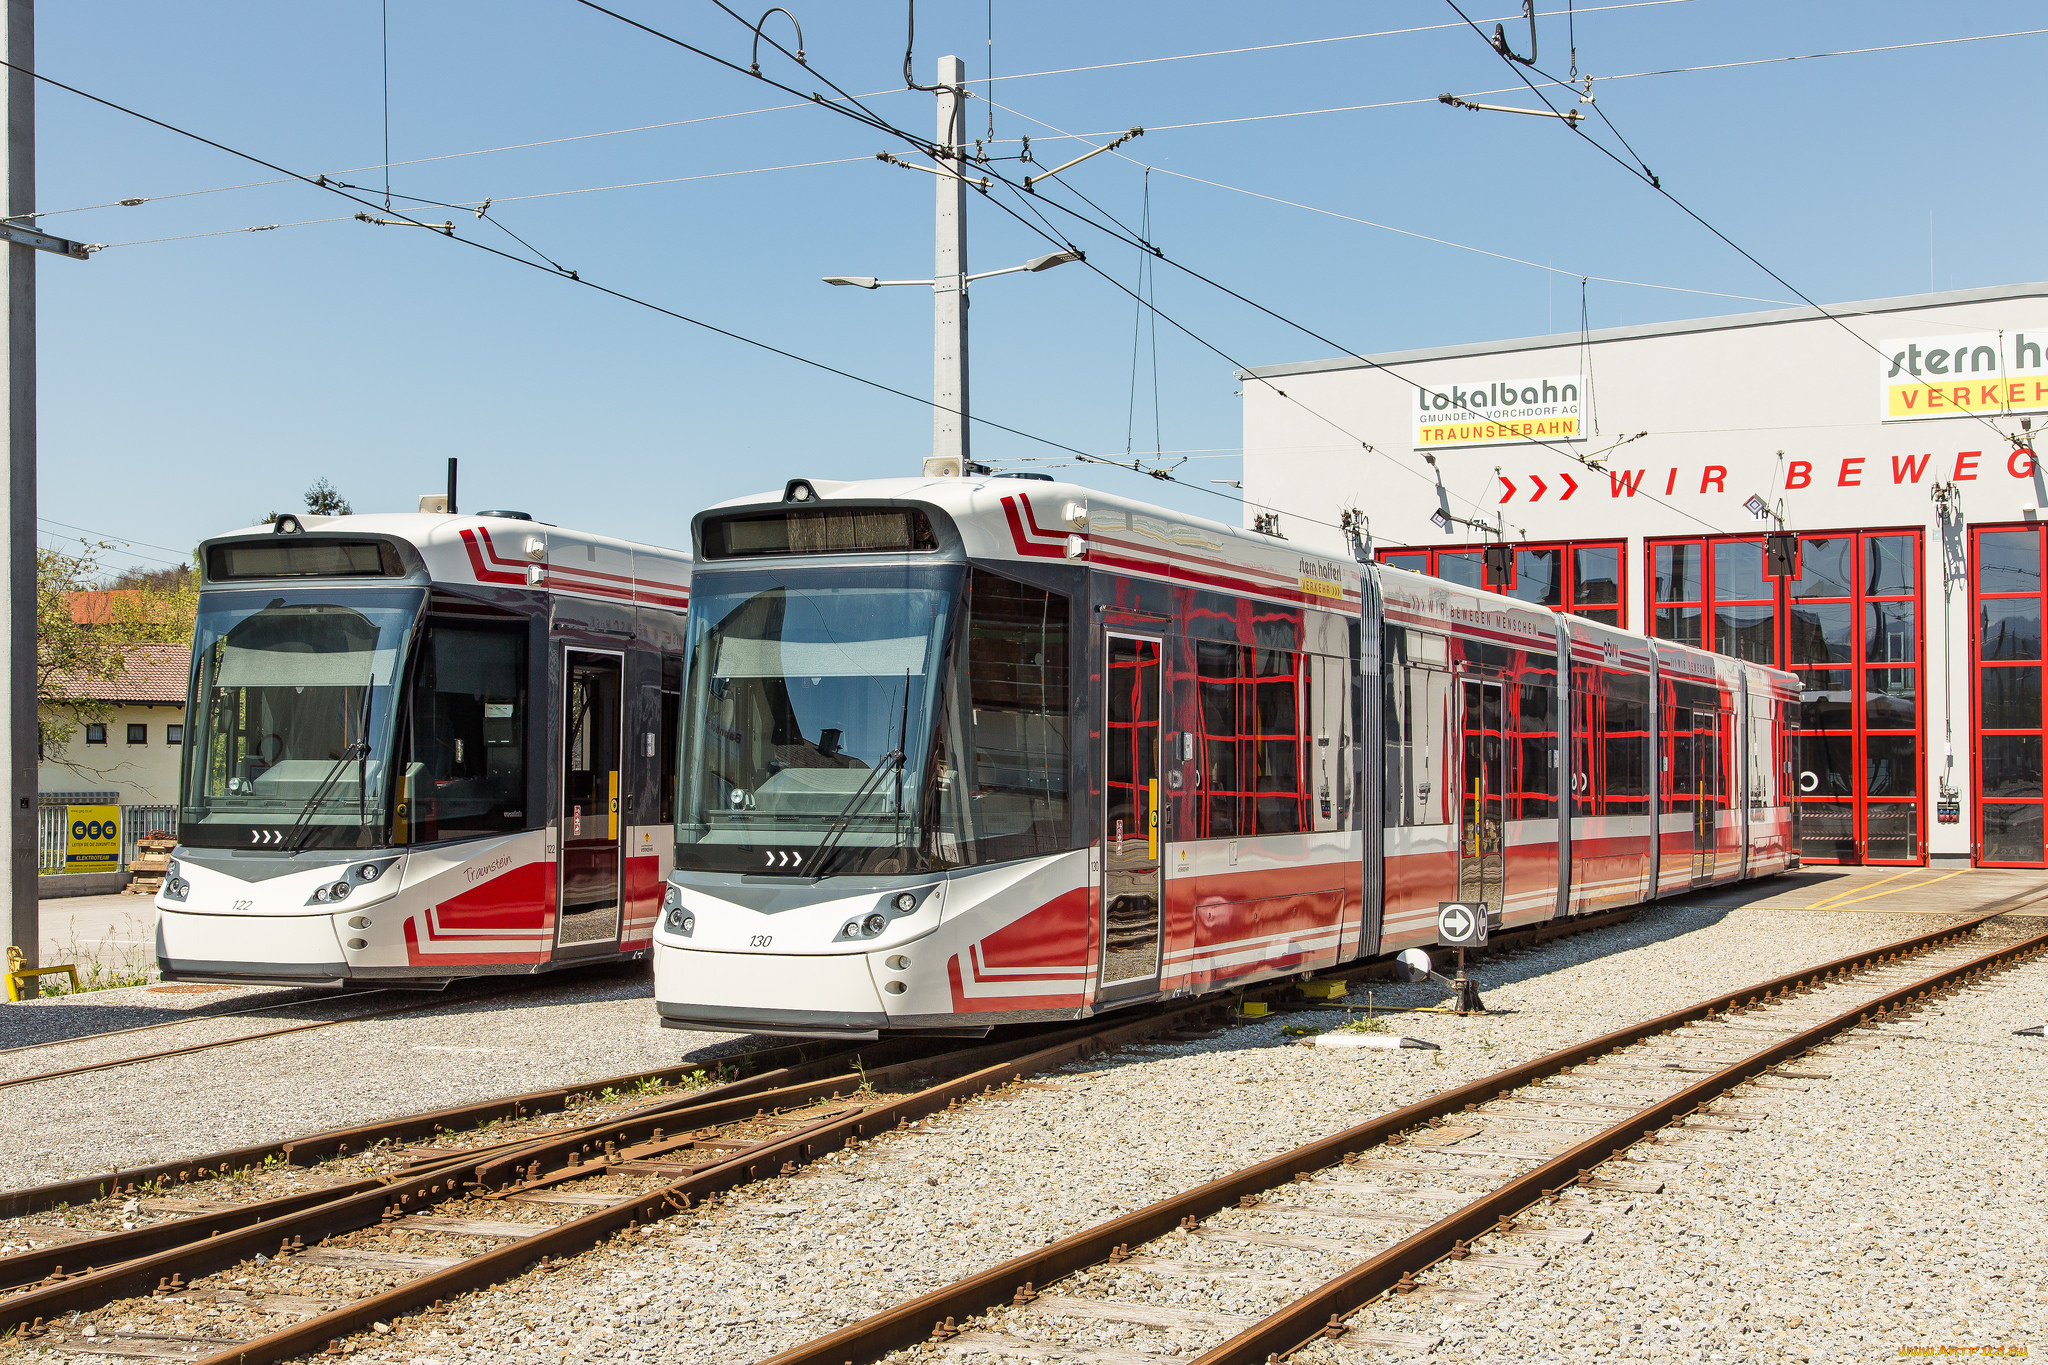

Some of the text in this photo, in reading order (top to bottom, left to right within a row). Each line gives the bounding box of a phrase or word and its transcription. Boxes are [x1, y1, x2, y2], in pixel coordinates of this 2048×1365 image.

[1888, 333, 2048, 378] stern h
[1420, 405, 1578, 423] GMUNDEN VORCHDORF AG
[1423, 420, 1573, 442] TRAUNSEEBAHN
[1609, 448, 2038, 498] WIR BEWEG
[1299, 557, 1342, 582] stern hafferl
[1301, 579, 1331, 595] VERKEHR
[1428, 599, 1538, 637] WIR BEWEGEN MENSCHEN
[74, 824, 114, 836] GEG
[547, 844, 556, 854] 122
[463, 853, 513, 883] Traunstein
[232, 899, 254, 911] 122
[749, 935, 773, 948] 130
